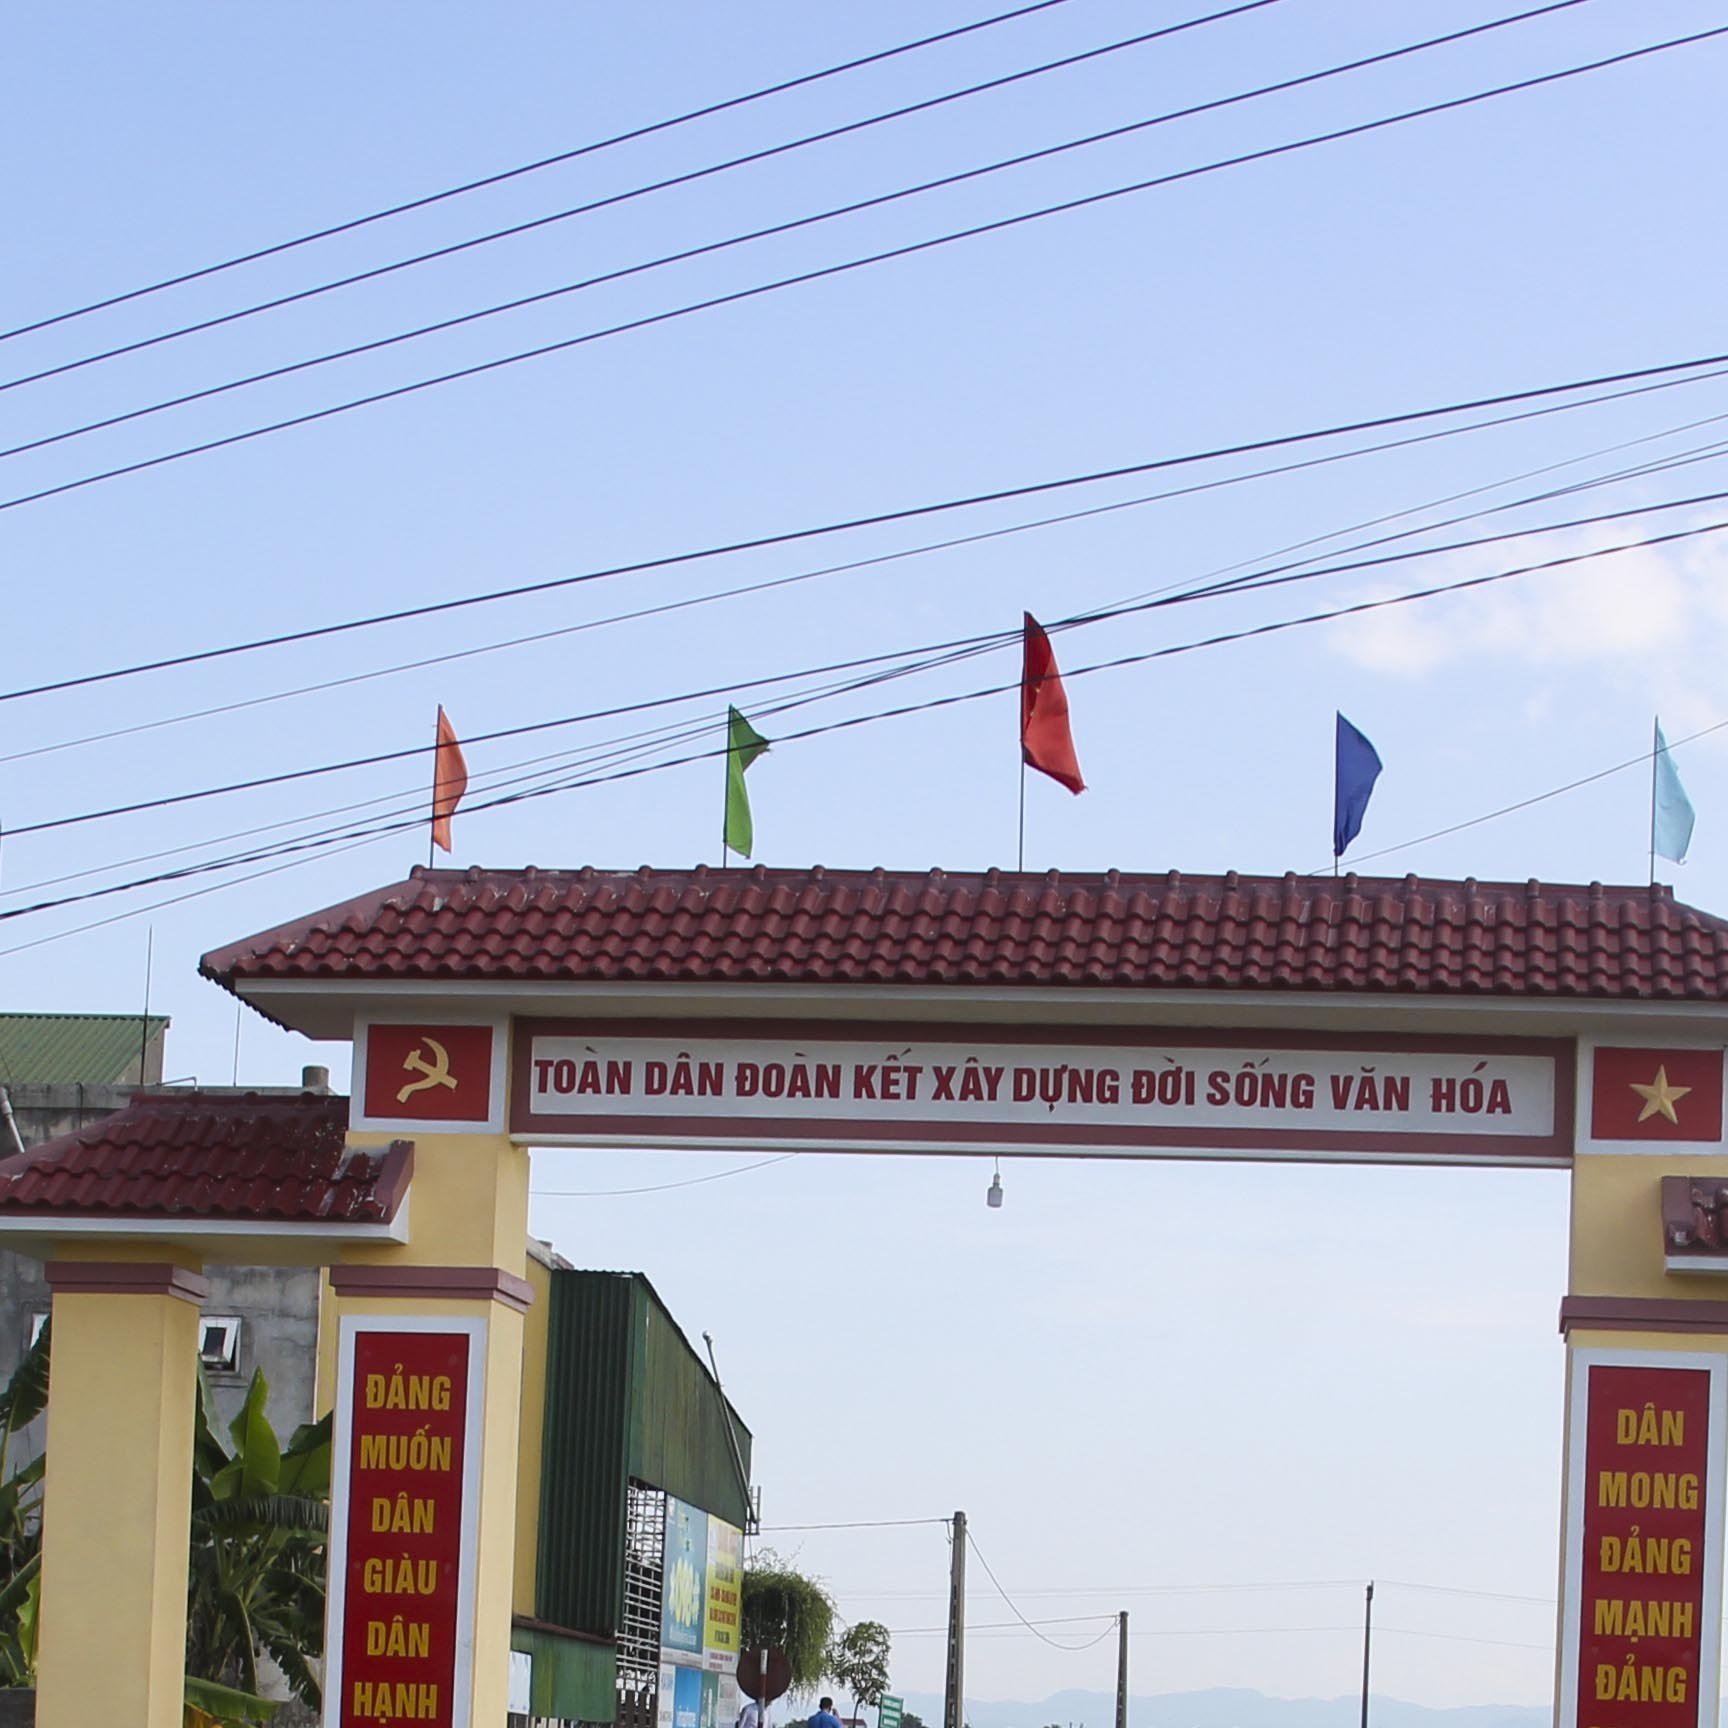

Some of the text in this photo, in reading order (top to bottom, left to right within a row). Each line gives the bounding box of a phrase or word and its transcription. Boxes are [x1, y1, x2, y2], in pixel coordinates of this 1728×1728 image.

[534, 1045, 1513, 1115] TOÀN DÂN ĐOÀN KẾT XÂY DỰNG ĐỜI SỐNG VĂN HÓA
[365, 1362, 452, 1411] ĐẢNG
[1616, 1402, 1685, 1446] DÂN
[359, 1423, 452, 1472] MUỐN
[371, 1491, 435, 1534] DÂN
[1598, 1471, 1699, 1510] MONG
[1599, 1525, 1692, 1575] ĐẢNG
[363, 1552, 438, 1596] GIÀU
[366, 1614, 430, 1658] DÂN
[1593, 1599, 1693, 1643] MẠNH
[1594, 1653, 1687, 1703] ĐẢNG
[353, 1681, 439, 1725] HẠNH
